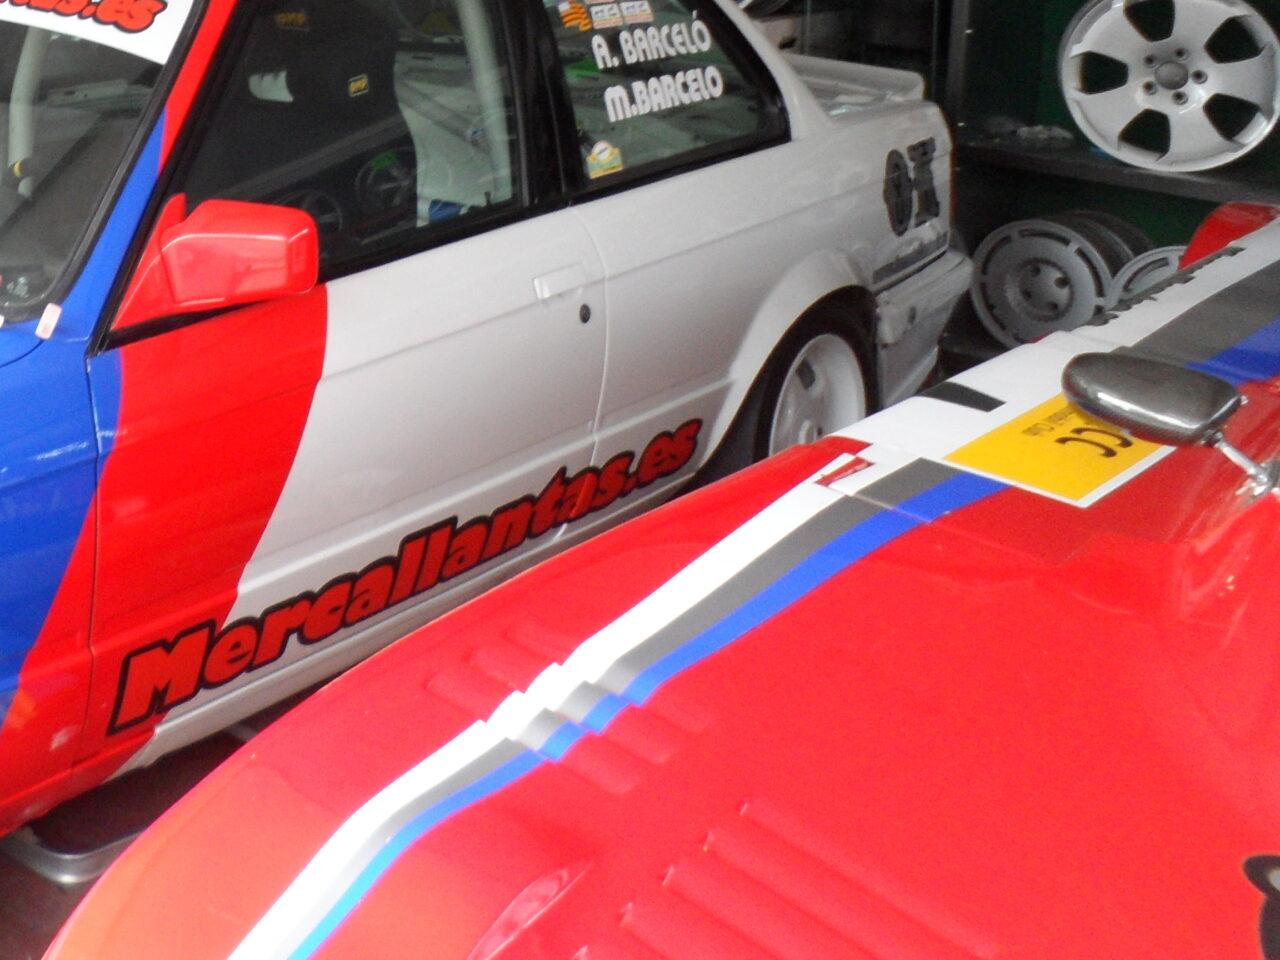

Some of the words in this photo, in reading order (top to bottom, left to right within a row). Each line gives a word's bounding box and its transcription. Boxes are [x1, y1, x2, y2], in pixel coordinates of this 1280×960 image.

[591, 34, 620, 70] A.
[619, 9, 712, 65] BARCELÓ
[106, 418, 704, 736] Mercallantas.es
